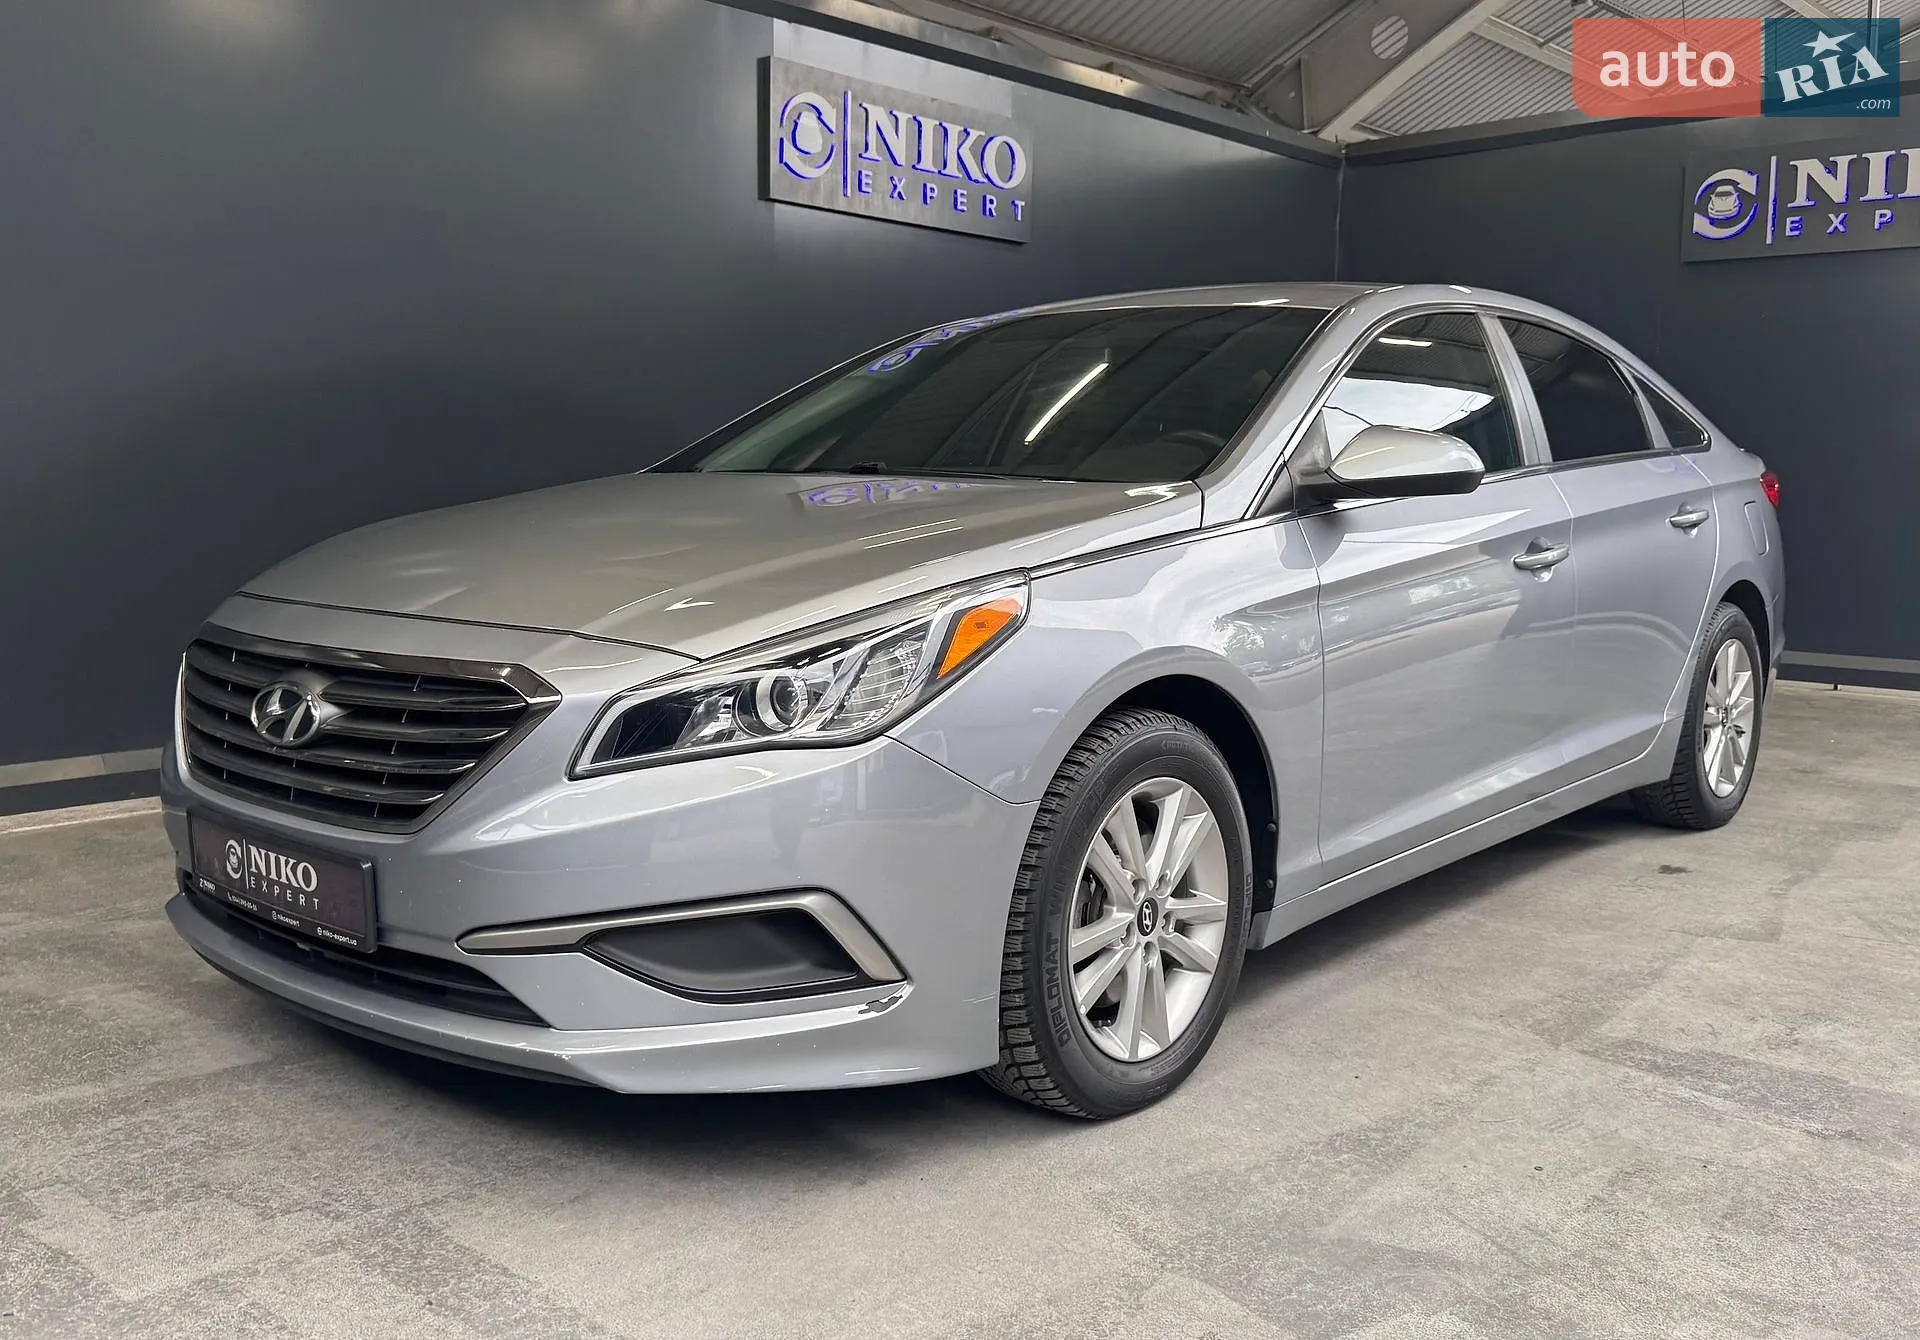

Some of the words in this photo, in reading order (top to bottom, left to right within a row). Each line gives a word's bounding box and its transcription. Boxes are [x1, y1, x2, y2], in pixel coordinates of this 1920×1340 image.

[858, 102, 1026, 189] NIKO
[857, 169, 1026, 222] EXPERT
[248, 844, 318, 892] NIKO
[250, 876, 319, 911] EXPERT
[1045, 931, 1072, 1047] DIPLOMAT
